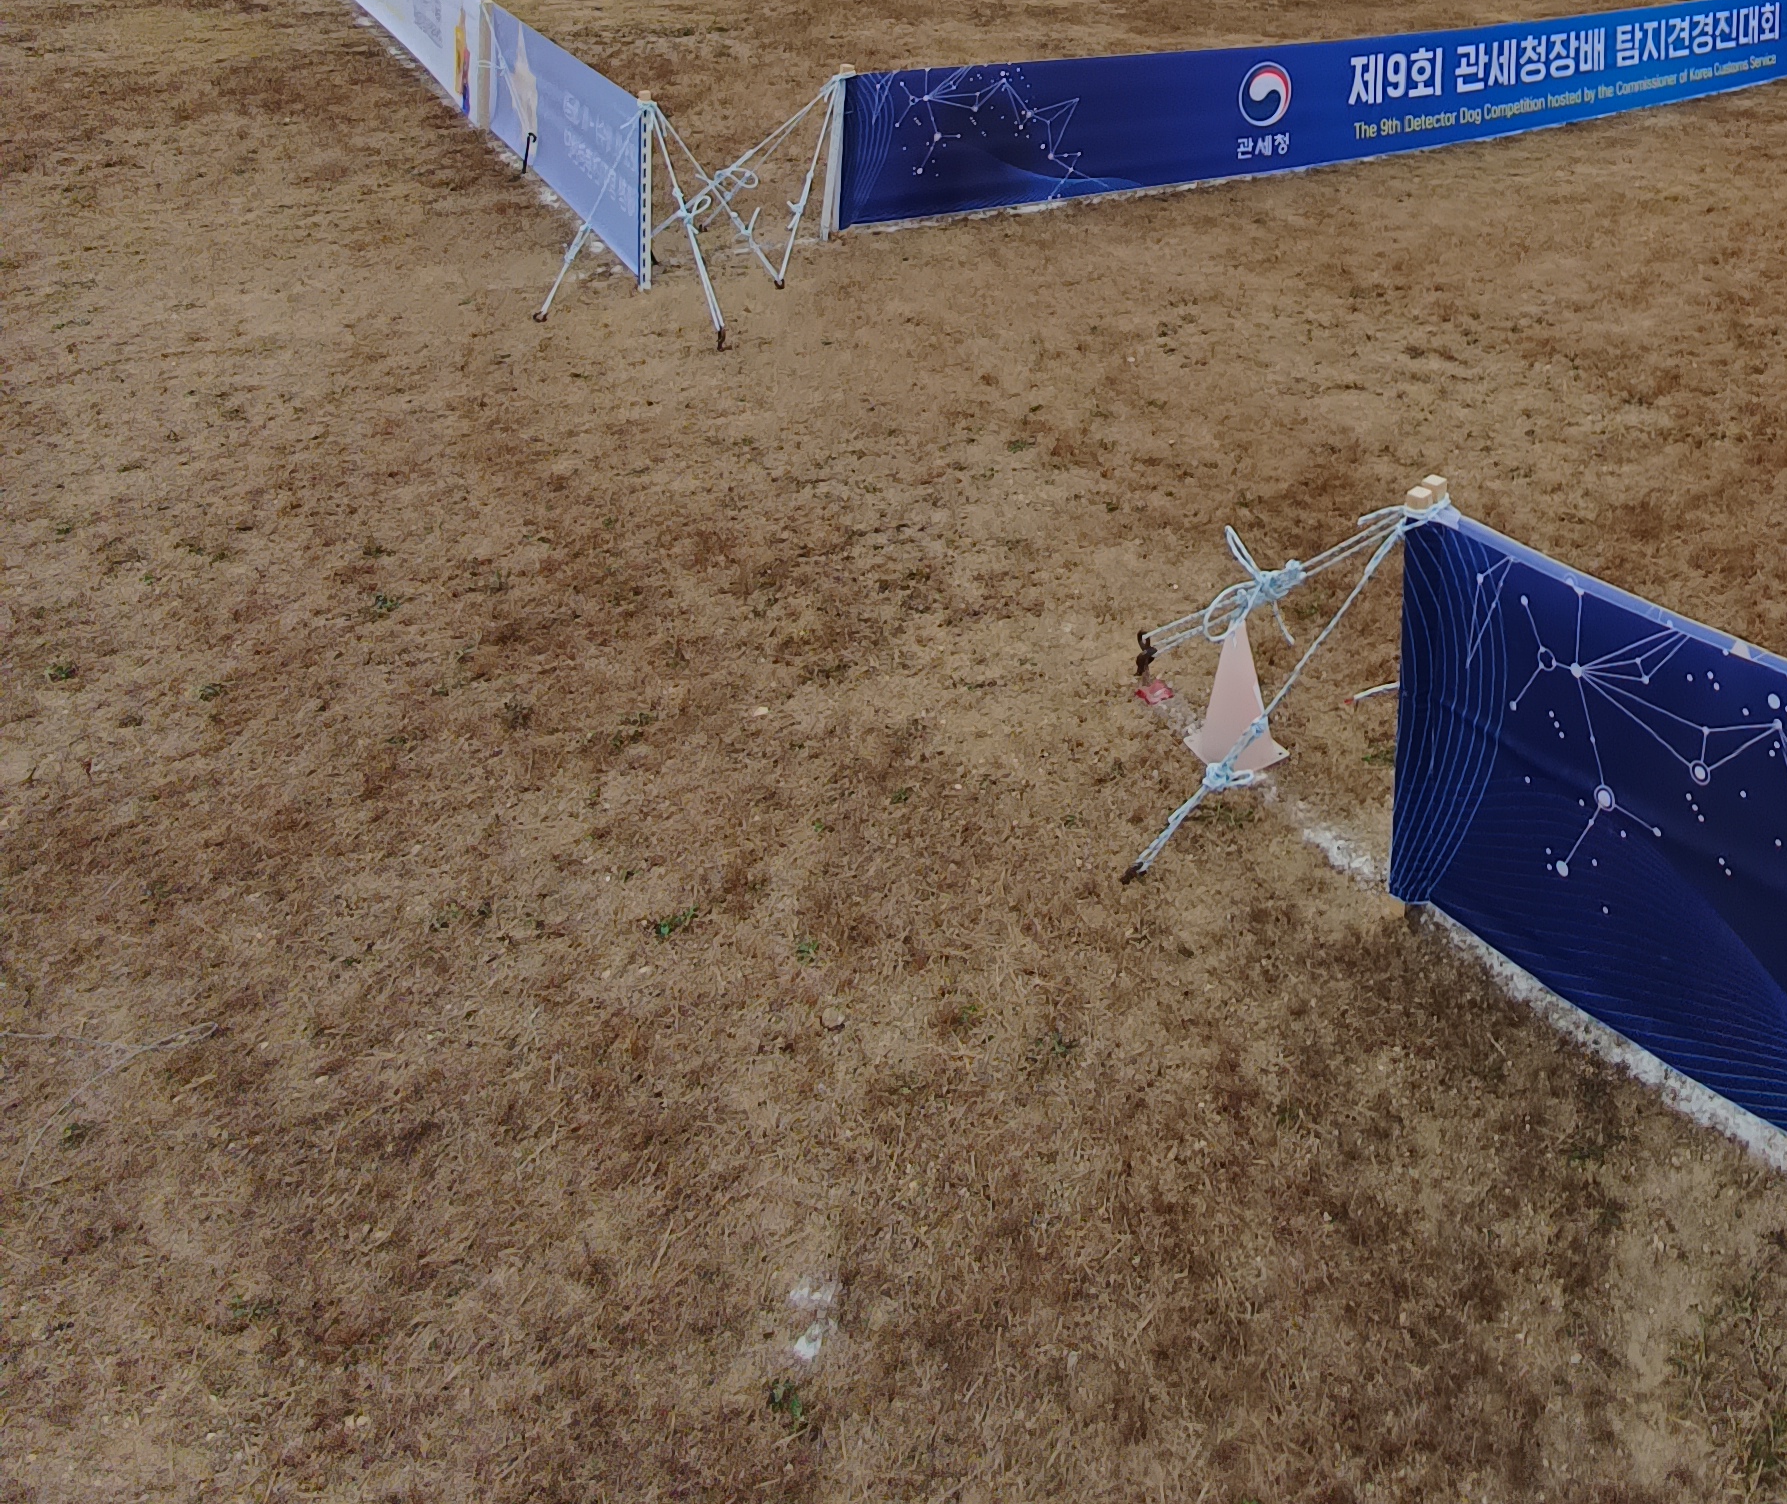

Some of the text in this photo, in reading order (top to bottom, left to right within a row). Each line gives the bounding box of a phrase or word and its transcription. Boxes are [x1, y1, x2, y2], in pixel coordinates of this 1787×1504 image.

[1347, 1, 1780, 106] 제9회 관세청장배 탐지견경진대회
[1354, 53, 1777, 140] The 9th Detector Dog Competition hosted by the Commissioner of Korea Customs Service
[1237, 132, 1291, 160] 관세청
